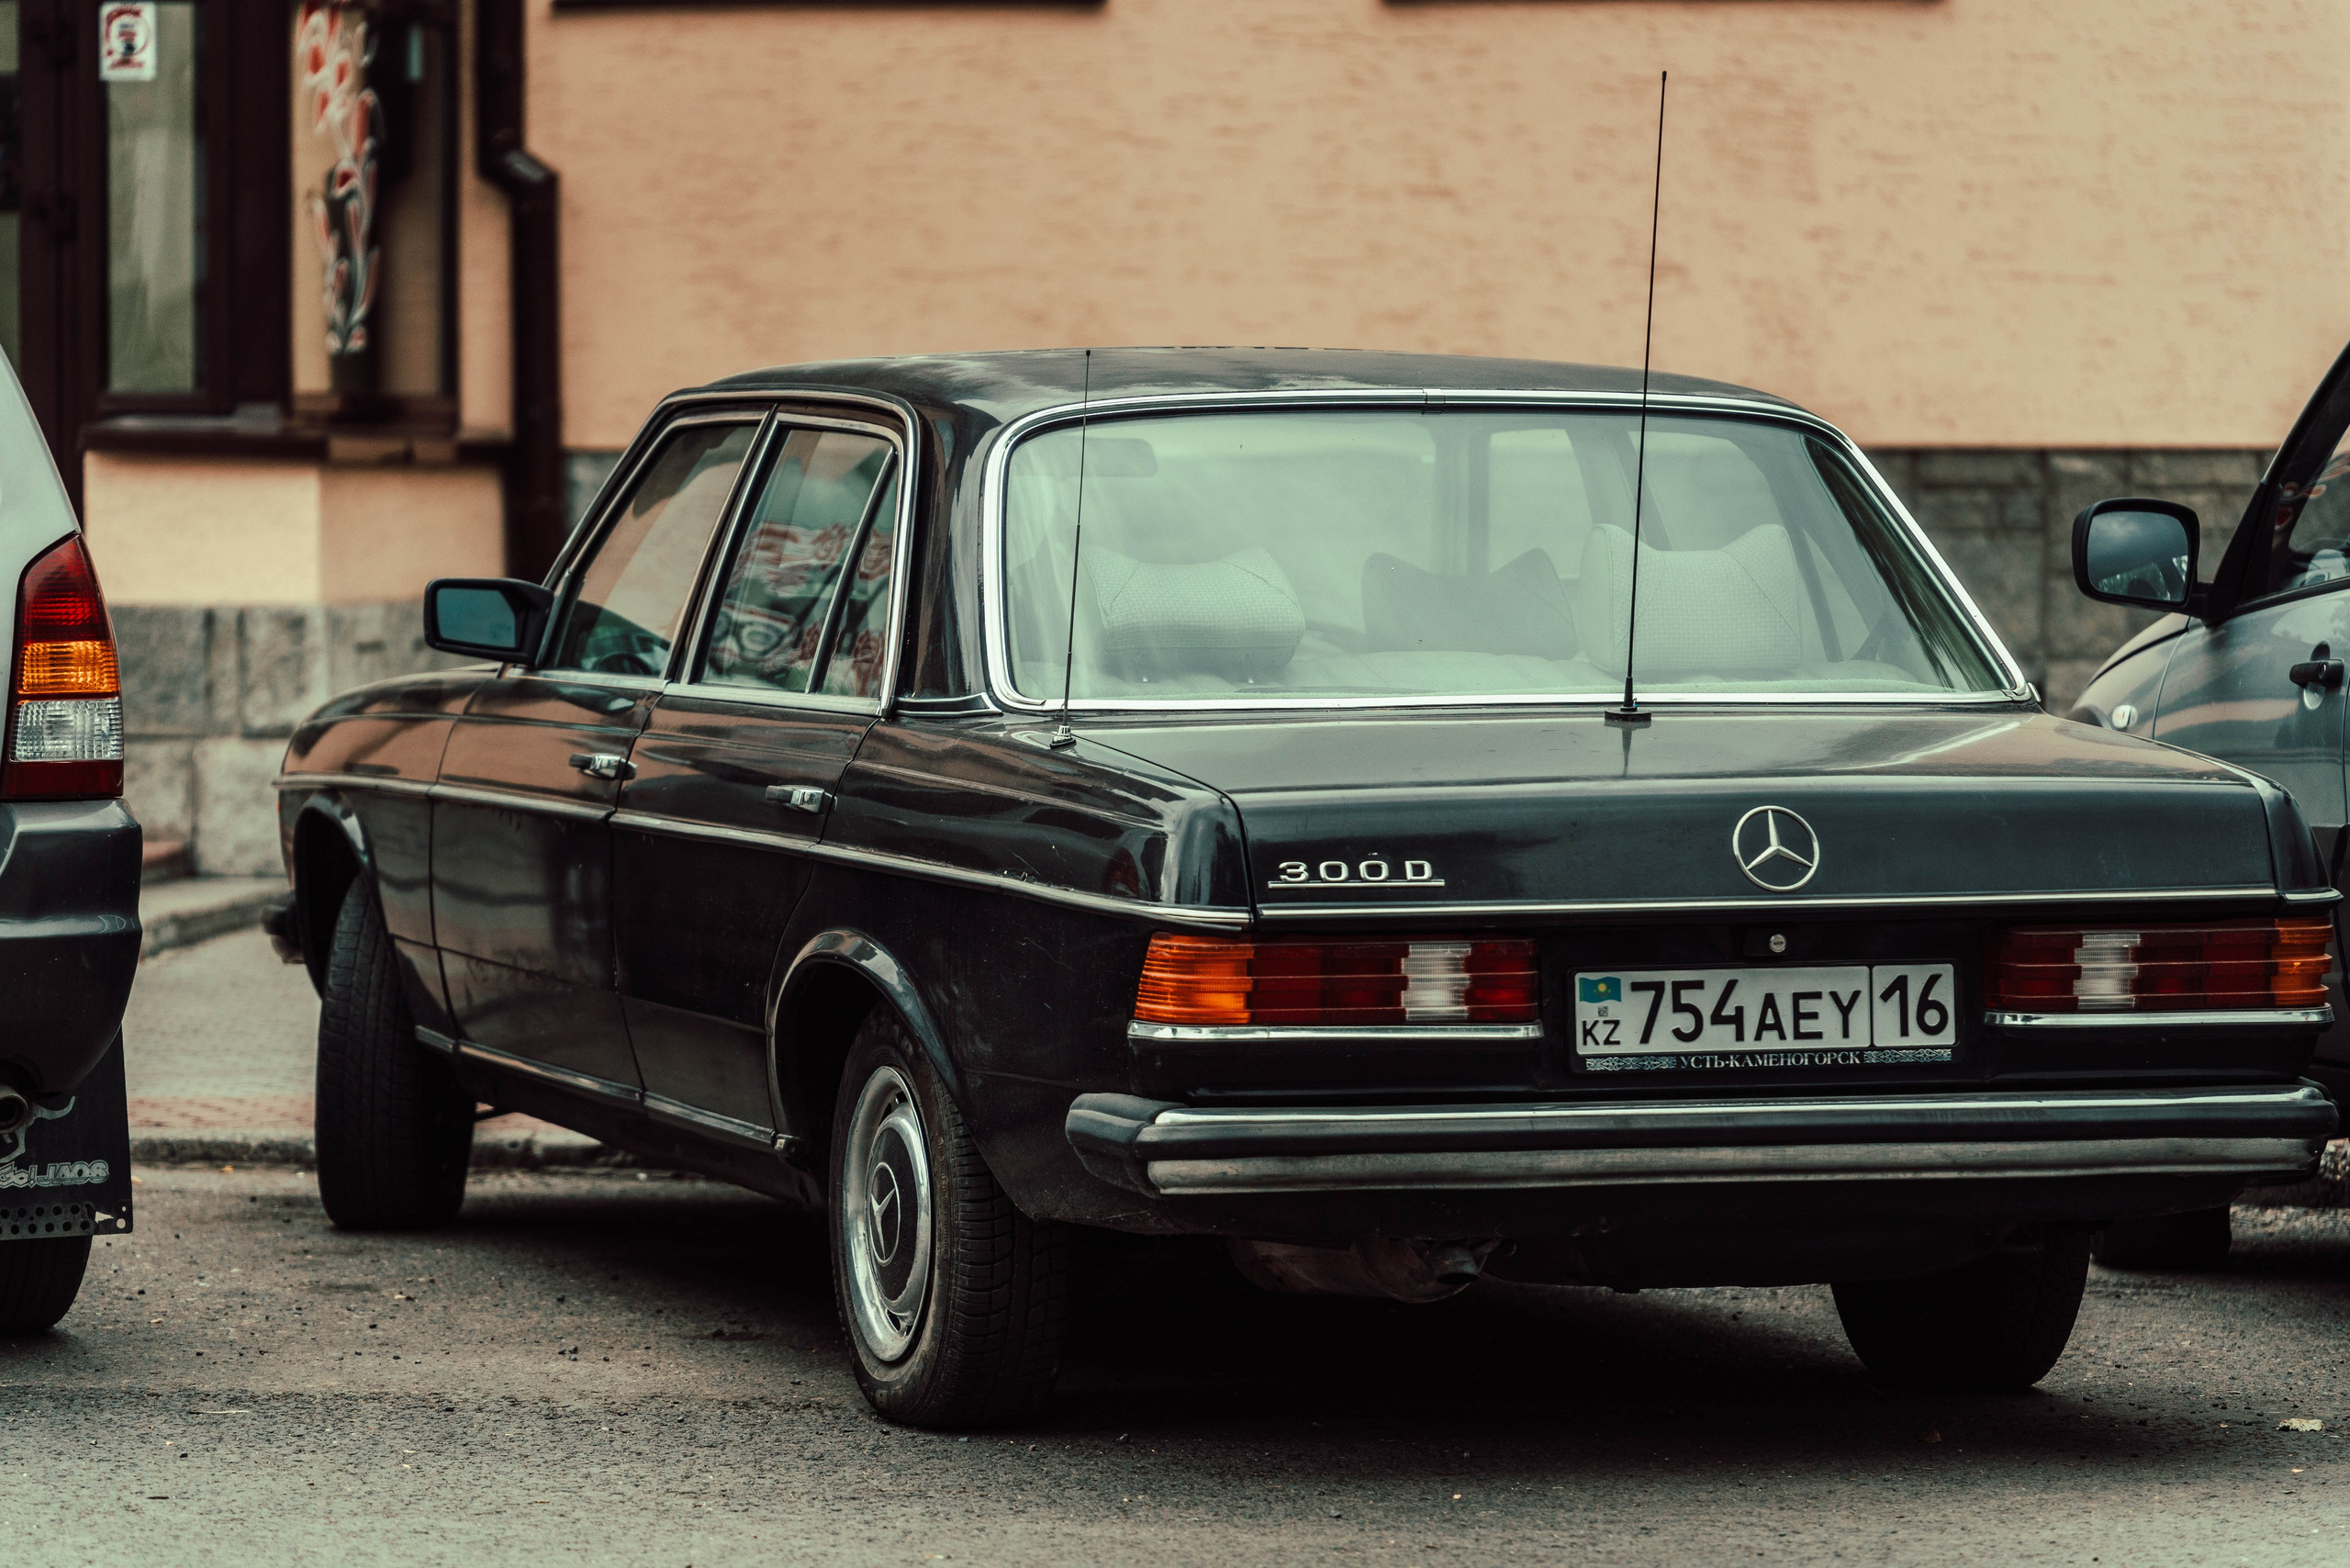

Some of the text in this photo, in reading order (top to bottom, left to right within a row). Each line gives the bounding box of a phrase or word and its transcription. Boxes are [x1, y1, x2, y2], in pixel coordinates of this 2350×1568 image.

[1278, 860, 1433, 882] 300 D
[1630, 973, 1949, 1045] 754AEY 16
[1582, 1019, 1621, 1047] KZ
[1679, 1051, 1861, 1070] УСТЬ-КАМЕНОГОРСК
[37, 1159, 109, 1187] JAOS
